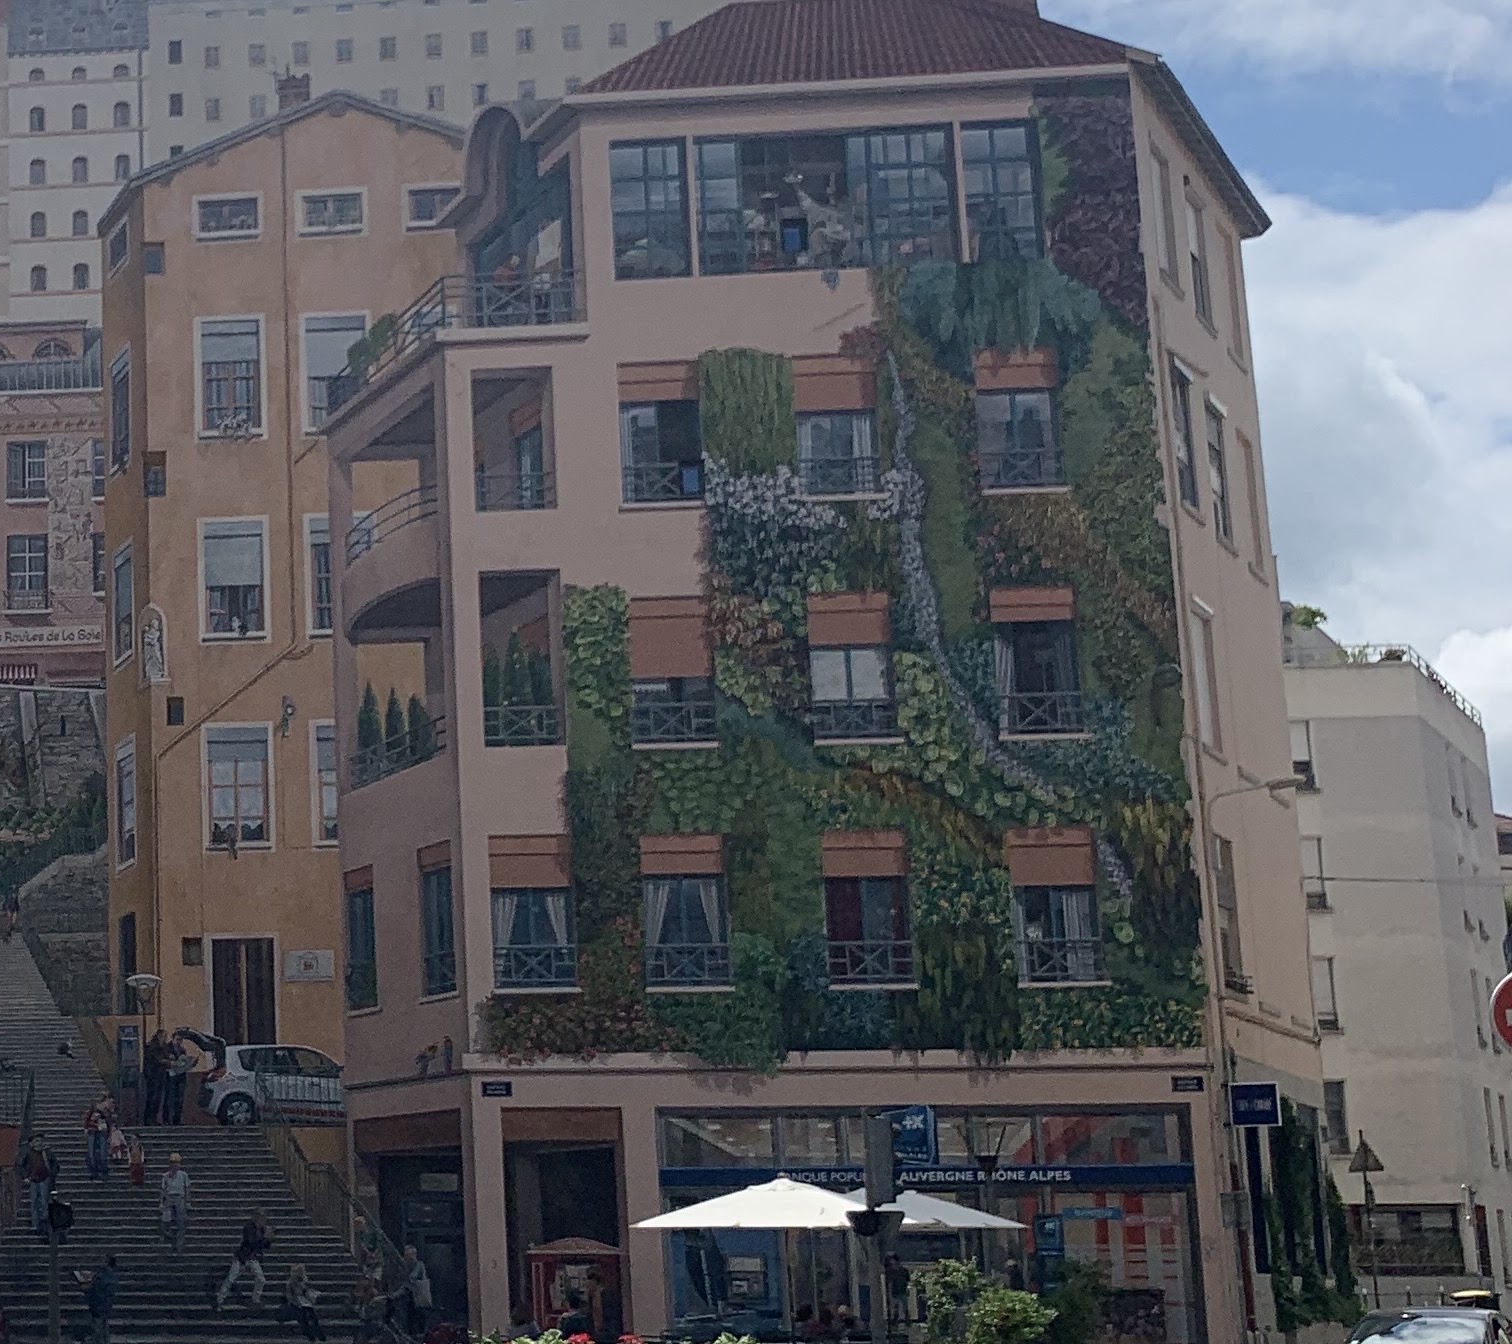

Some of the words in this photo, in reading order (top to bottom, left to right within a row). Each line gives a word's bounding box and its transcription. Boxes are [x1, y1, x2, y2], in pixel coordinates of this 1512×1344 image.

[47, 629, 60, 642] de
[900, 1171, 975, 1182] AUVERGNE
[1029, 1170, 1072, 1181] ALPES
